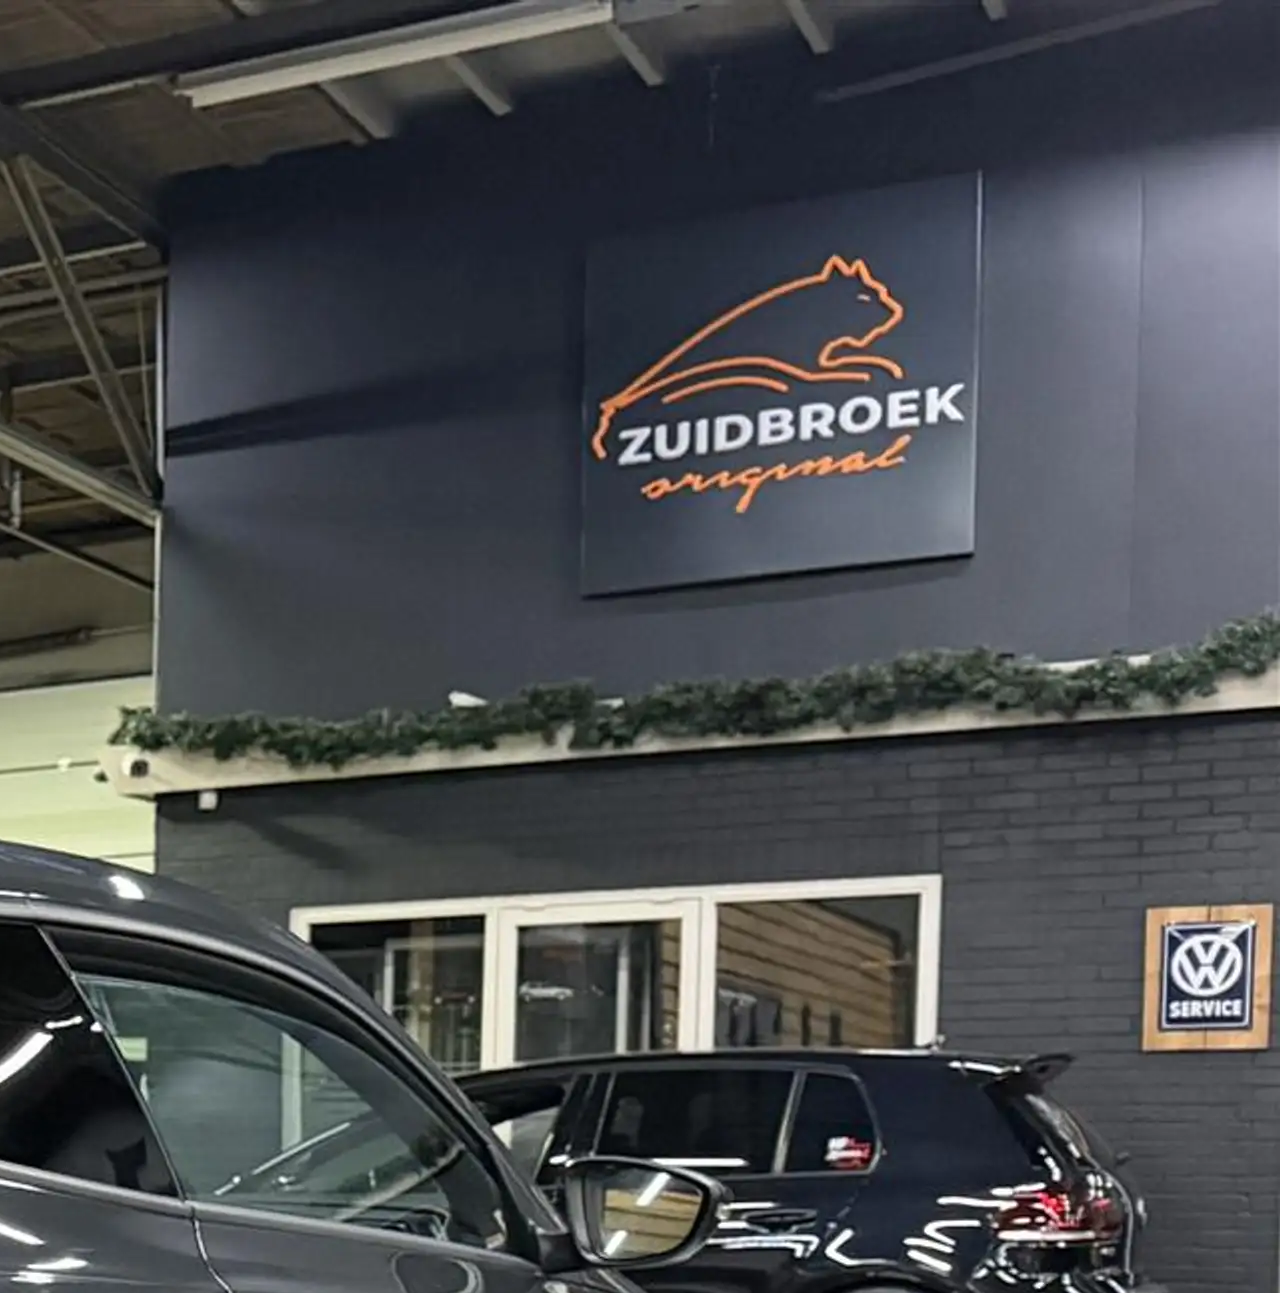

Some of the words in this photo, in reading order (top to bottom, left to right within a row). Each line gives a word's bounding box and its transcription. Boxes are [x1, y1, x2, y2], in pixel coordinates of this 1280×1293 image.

[618, 383, 965, 466] ZUIDBROEK
[641, 434, 912, 514] original
[1169, 999, 1242, 1018] SERVICE
